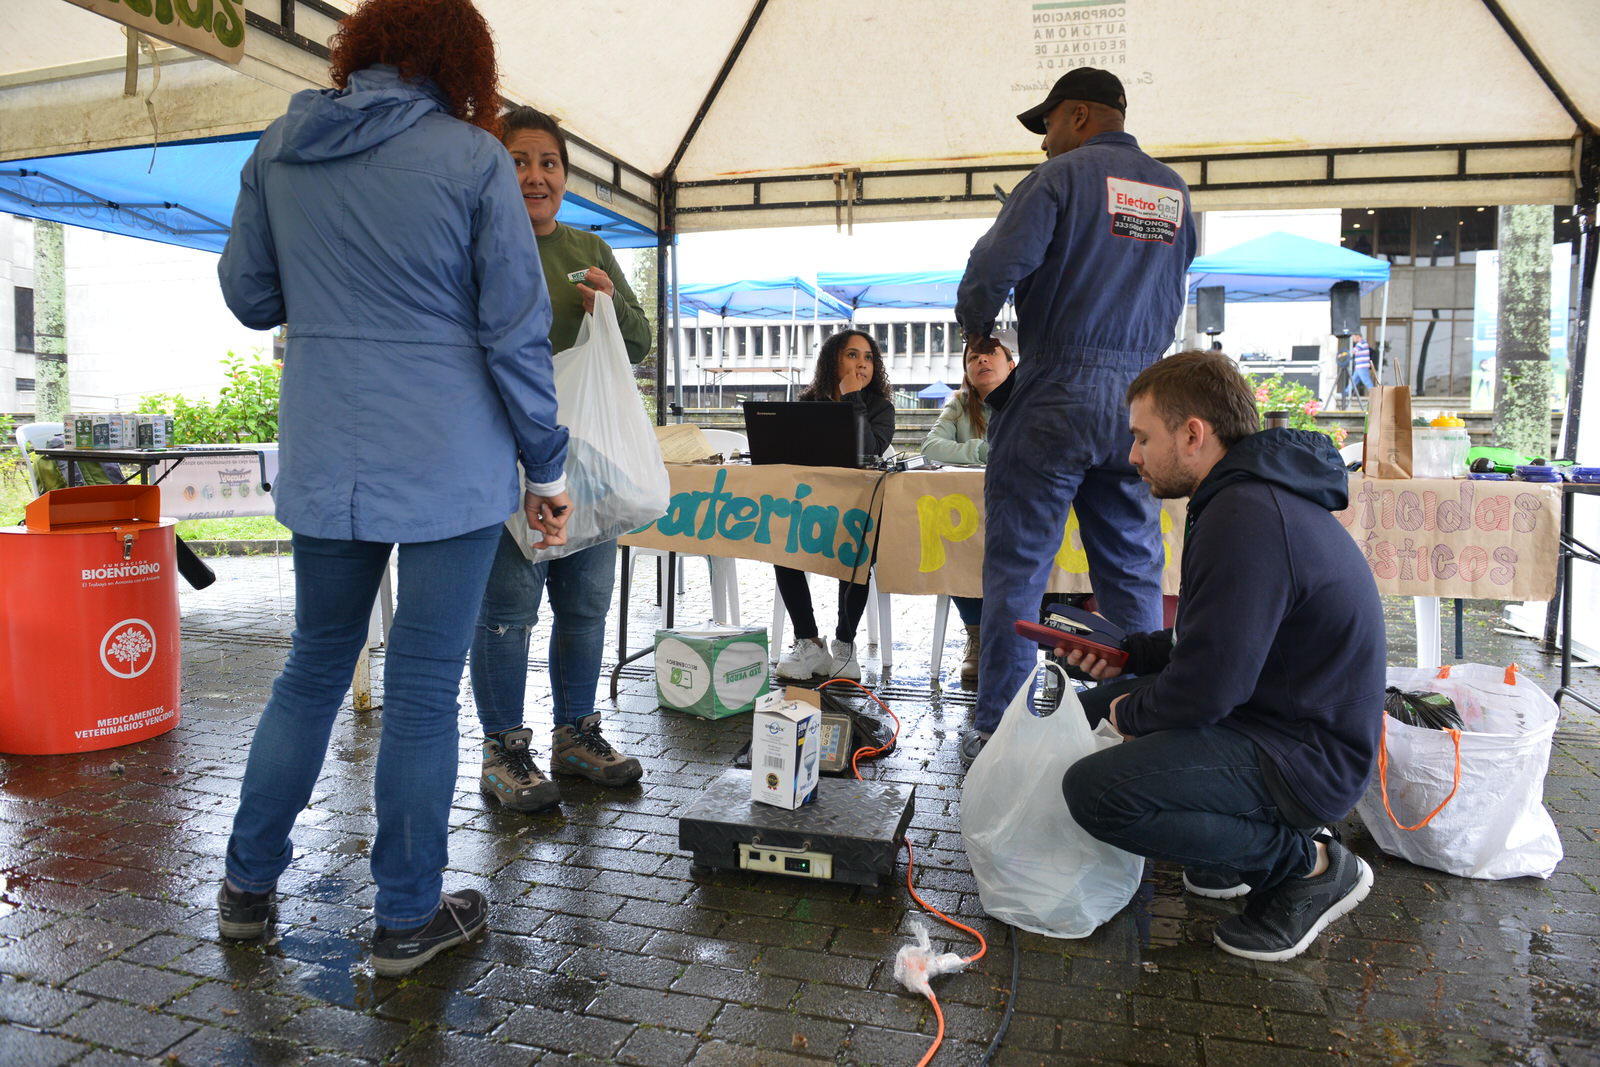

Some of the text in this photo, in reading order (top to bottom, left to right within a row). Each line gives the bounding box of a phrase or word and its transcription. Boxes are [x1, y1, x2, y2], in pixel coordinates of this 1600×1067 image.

[1116, 193, 1156, 210] Electro
[1158, 203, 1176, 216] gas
[1129, 230, 1164, 240] PEREIRA
[81, 562, 161, 580] BIOENTORNO
[725, 665, 762, 684] RED VERDE
[74, 709, 176, 739] VETERINARIOS VENCIDOS
[97, 706, 165, 728] MEDICAMENTOS
